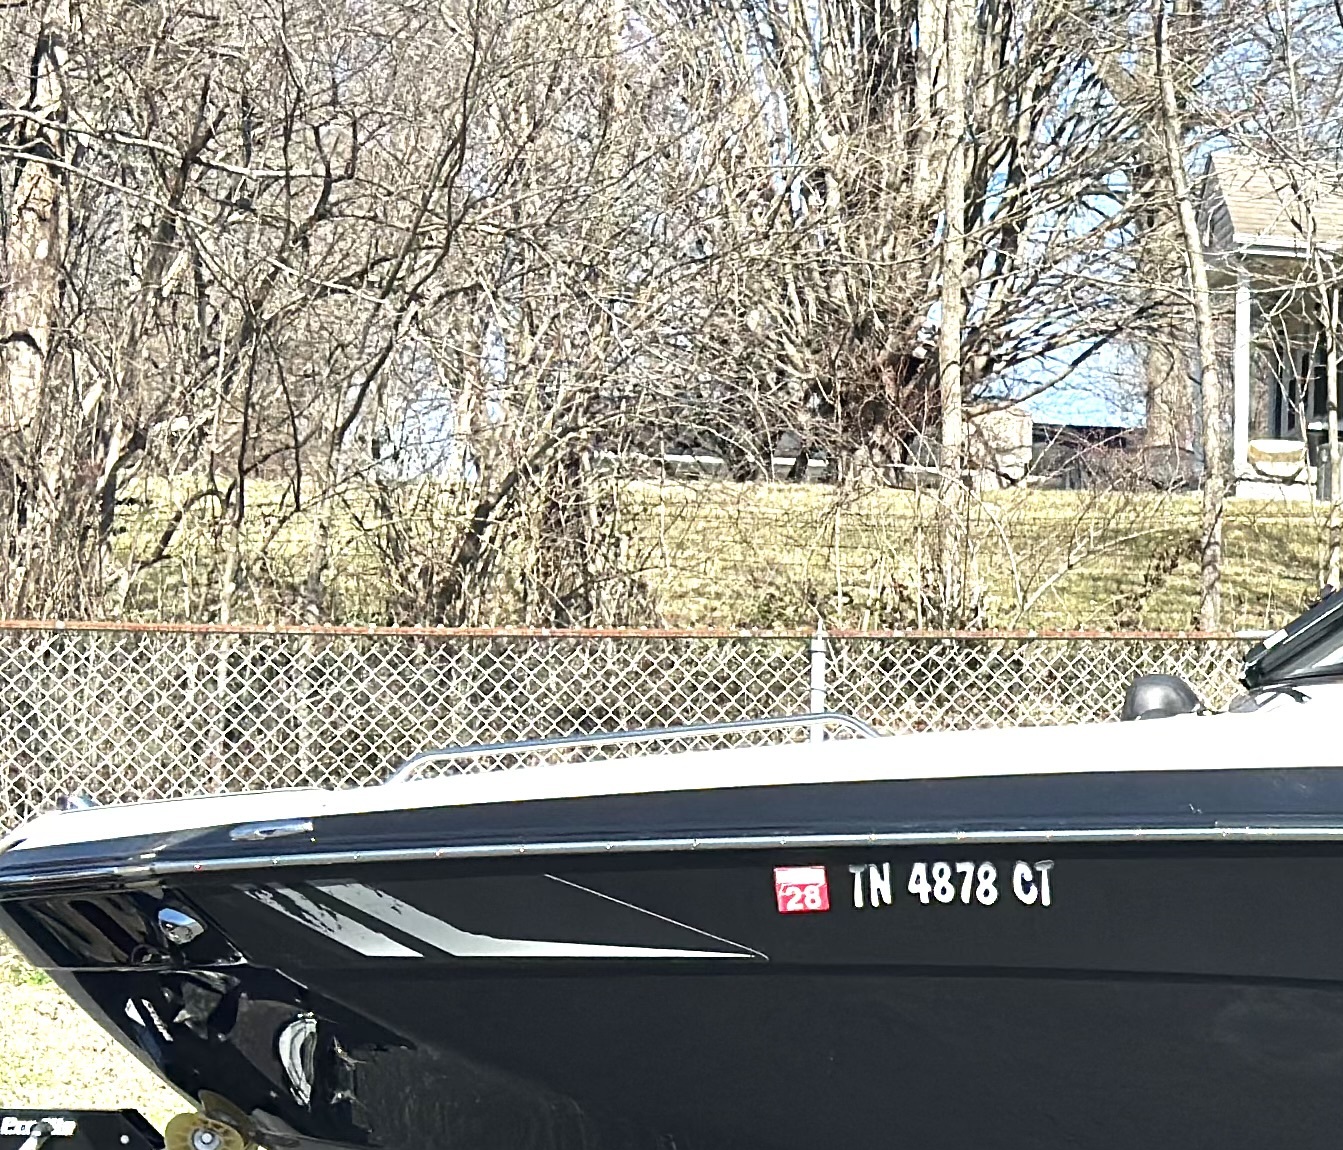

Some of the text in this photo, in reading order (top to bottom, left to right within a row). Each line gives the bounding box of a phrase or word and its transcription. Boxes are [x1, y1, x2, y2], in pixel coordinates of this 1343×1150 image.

[849, 860, 1054, 907] TN 4878 CT
